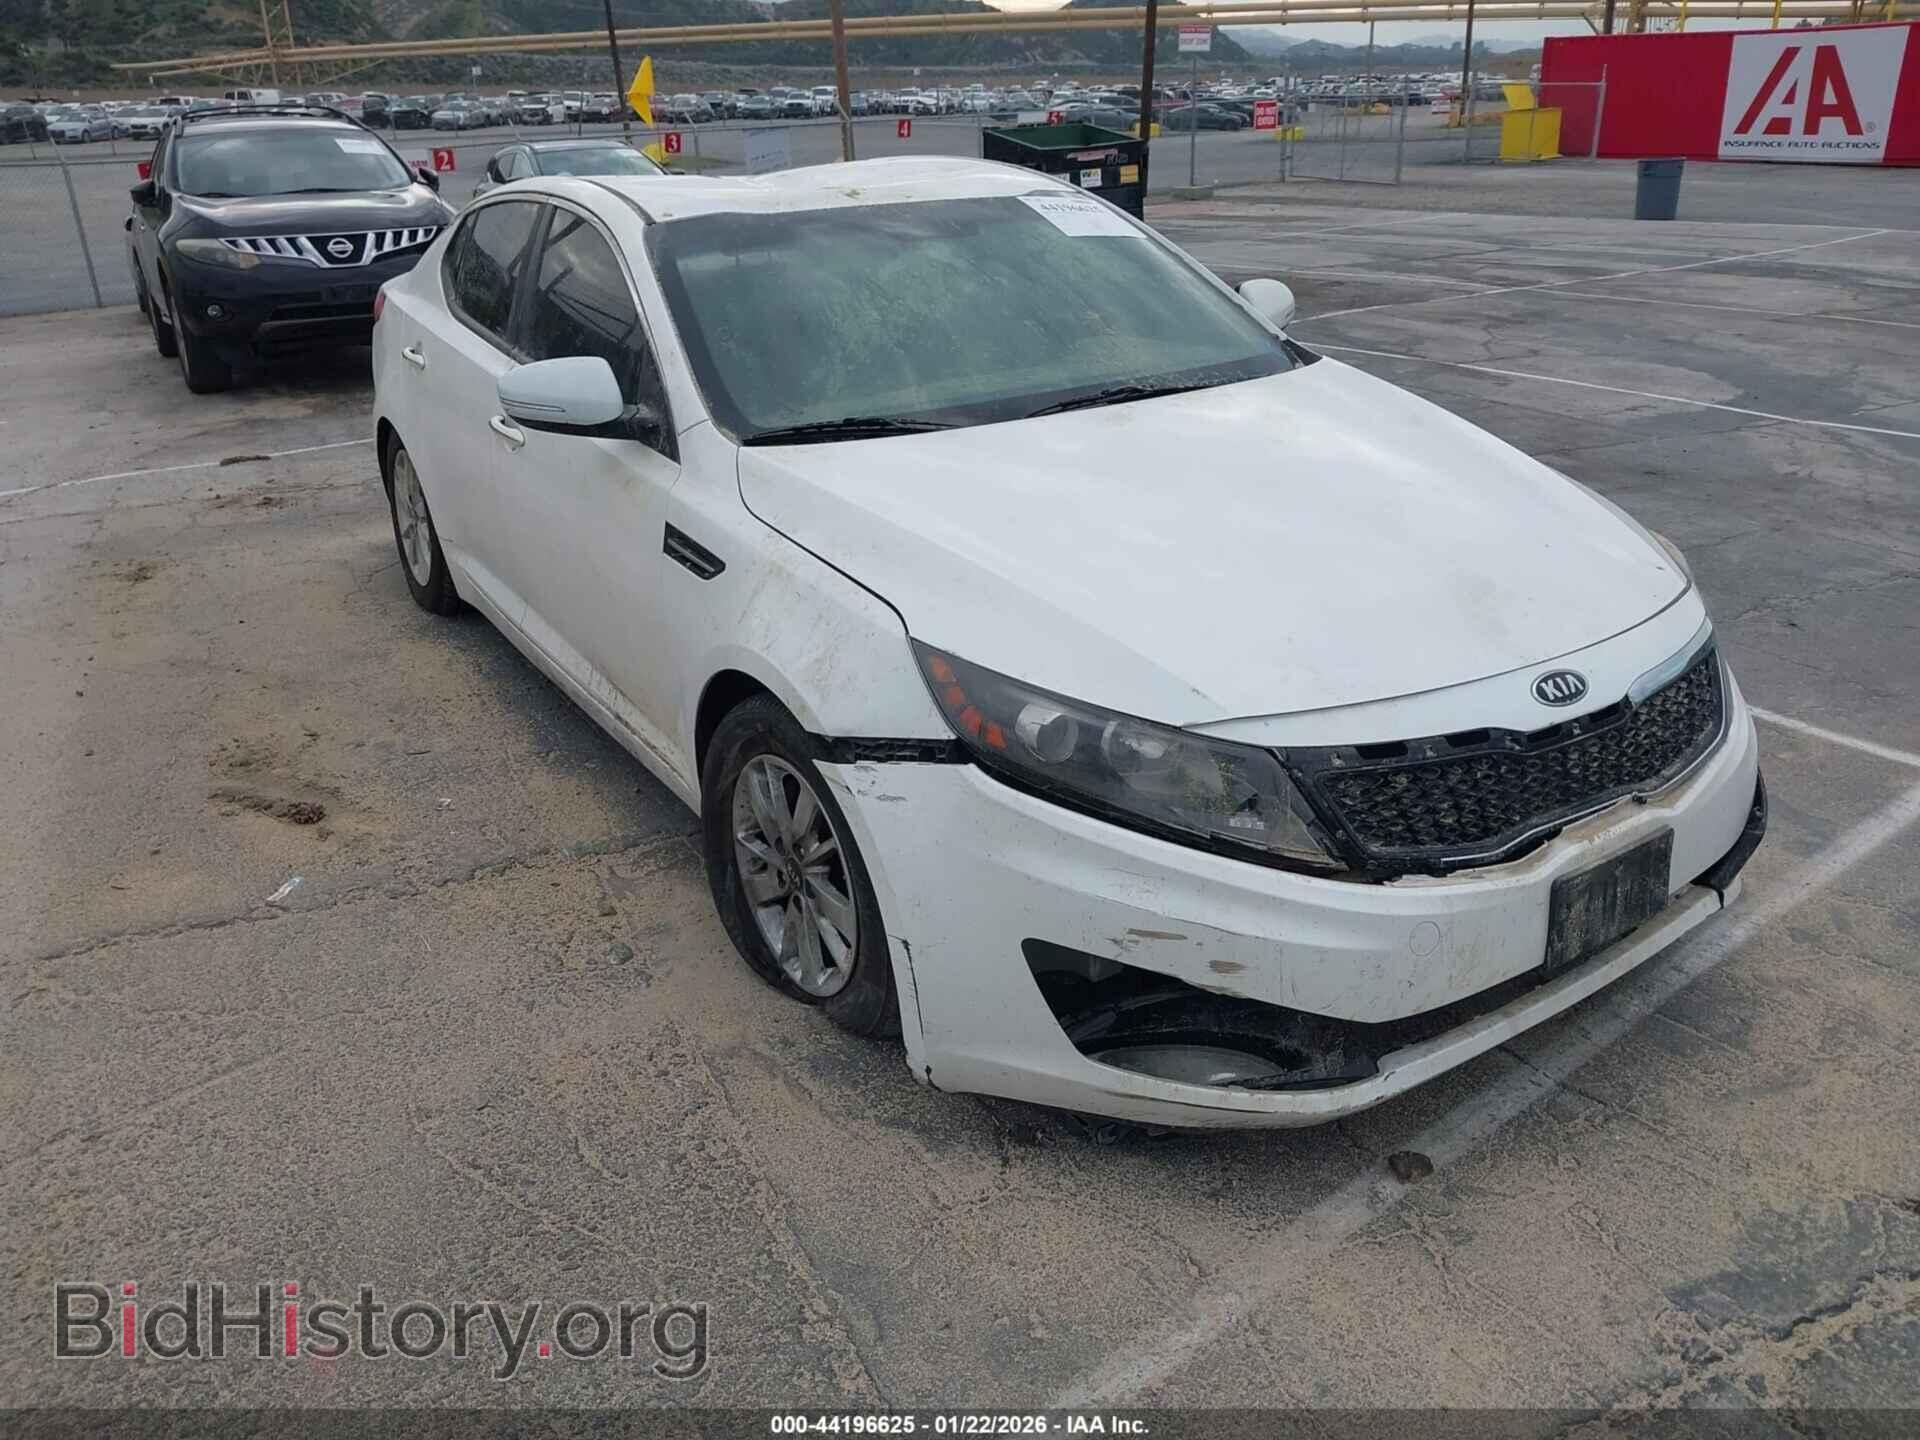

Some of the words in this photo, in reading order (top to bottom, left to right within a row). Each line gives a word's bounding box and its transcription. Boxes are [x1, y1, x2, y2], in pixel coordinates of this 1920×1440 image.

[900, 120, 908, 137] 4
[668, 134, 678, 152] 3
[1724, 140, 1784, 149] INSURANCE
[1788, 141, 1817, 149] AUTO
[1821, 141, 1880, 150] AUCTIONS
[438, 151, 451, 170] 2
[1539, 674, 1585, 700] KIA
